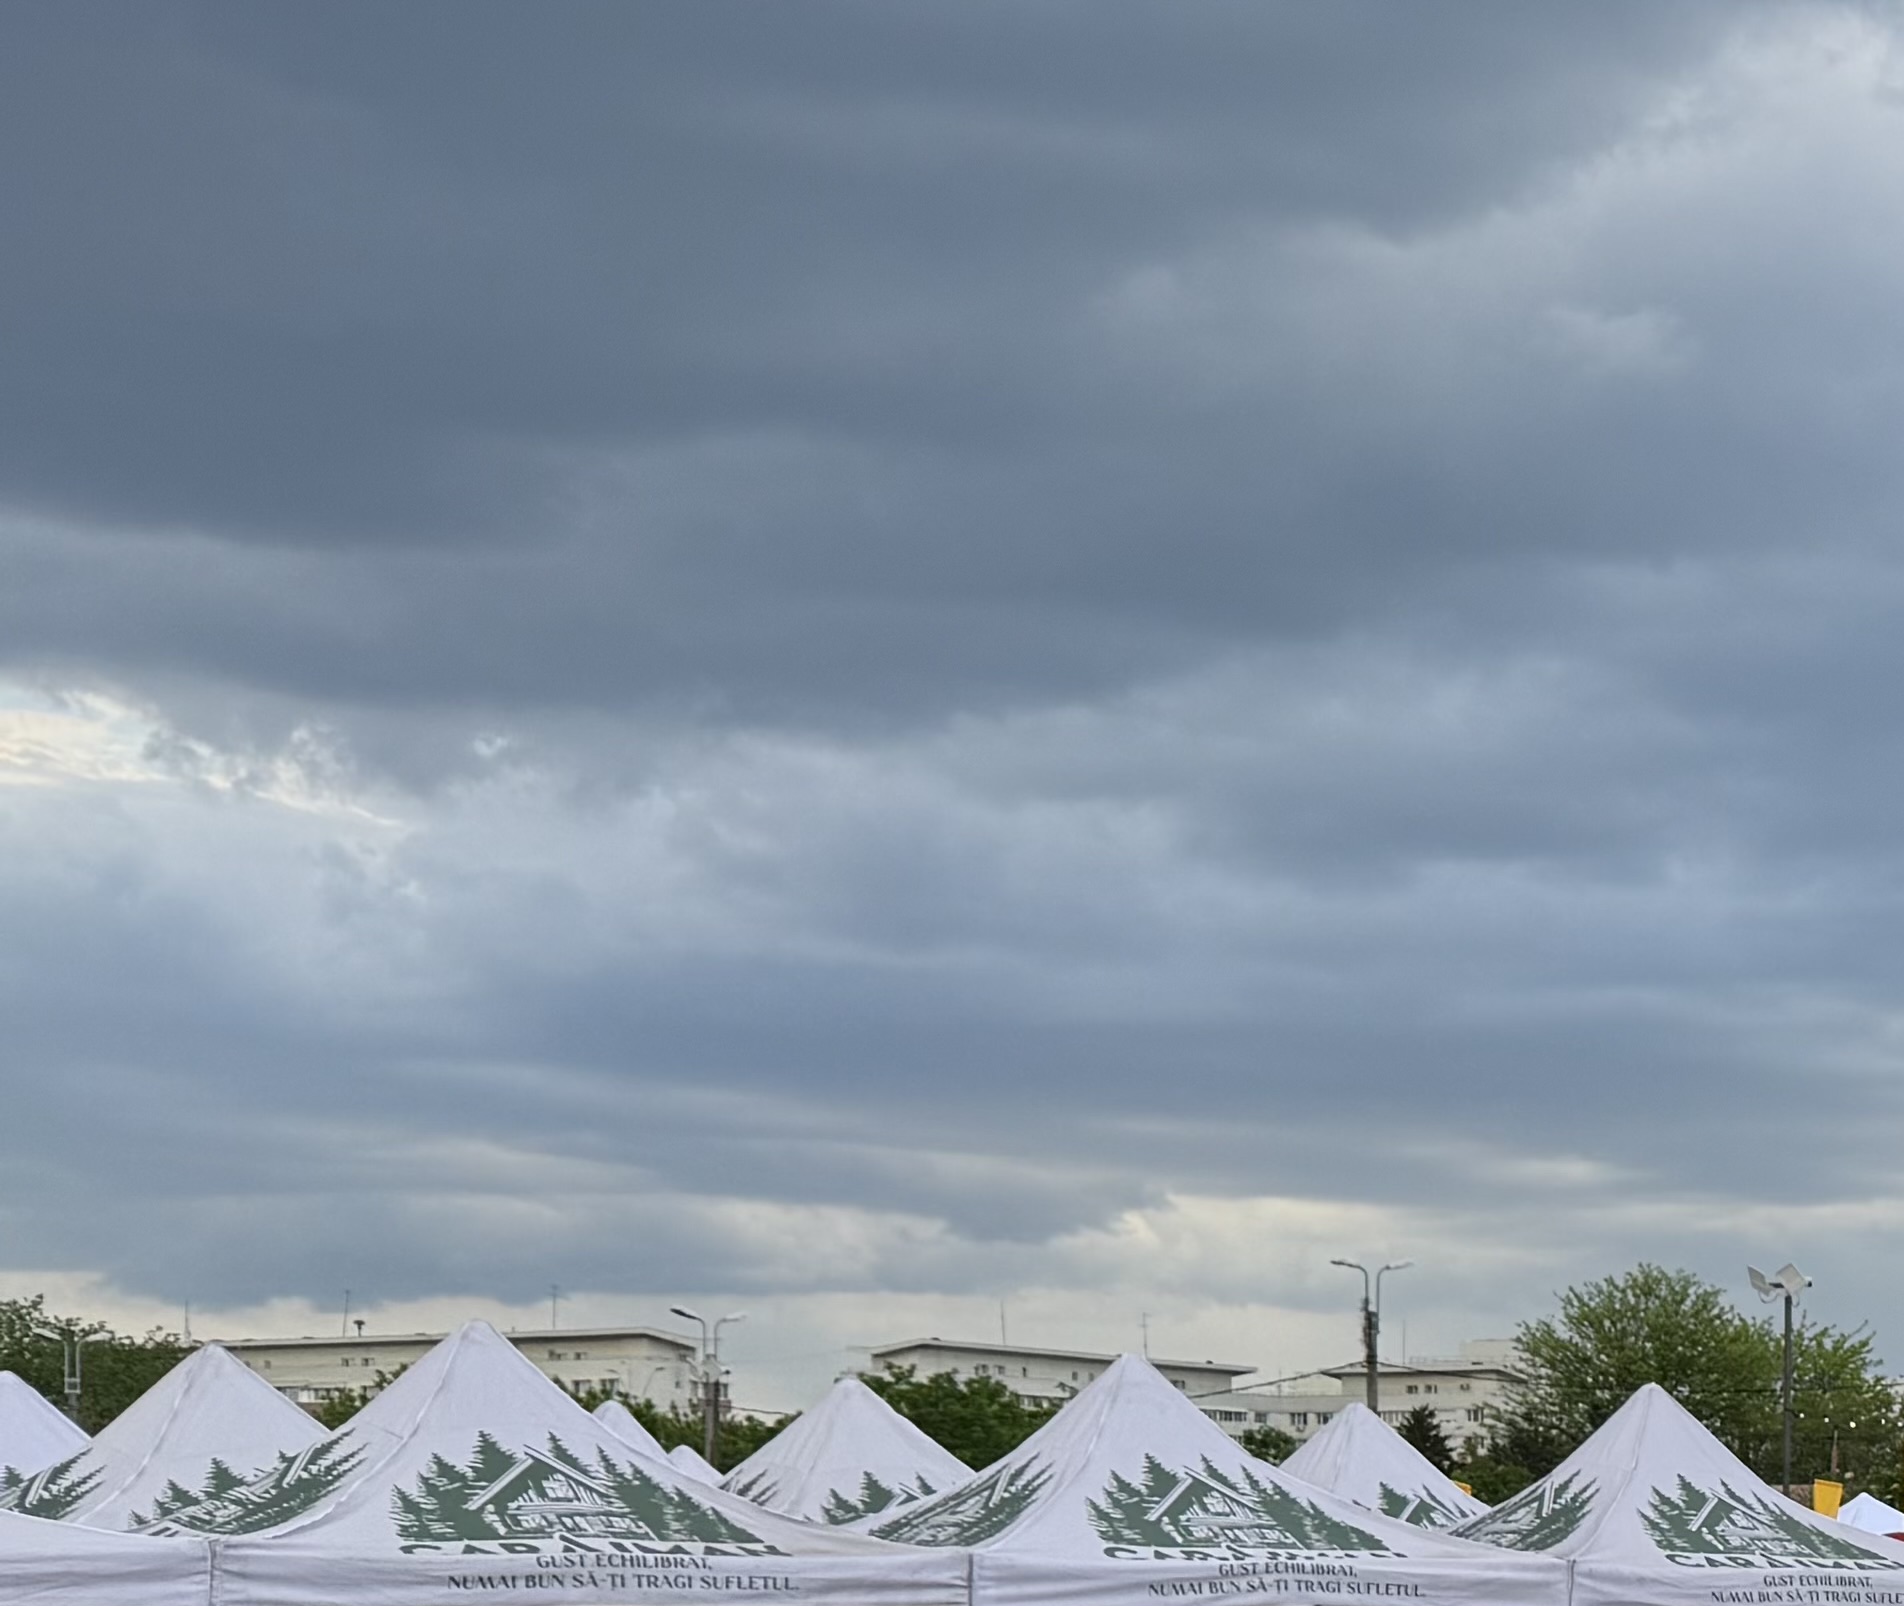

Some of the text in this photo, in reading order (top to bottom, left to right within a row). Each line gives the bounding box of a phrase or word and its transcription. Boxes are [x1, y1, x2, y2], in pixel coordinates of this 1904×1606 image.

[537, 1554, 586, 1569] GUST
[1219, 1562, 1259, 1577] GUST
[447, 1575, 517, 1591] NUMAI
[524, 1574, 565, 1589] BUN
[632, 1573, 693, 1589] TRAGI
[1209, 1580, 1241, 1595] BUN
[1295, 1578, 1342, 1594] TRAGI
[1764, 1574, 1797, 1587] GUST
[1822, 1589, 1861, 1603] TRAGI
